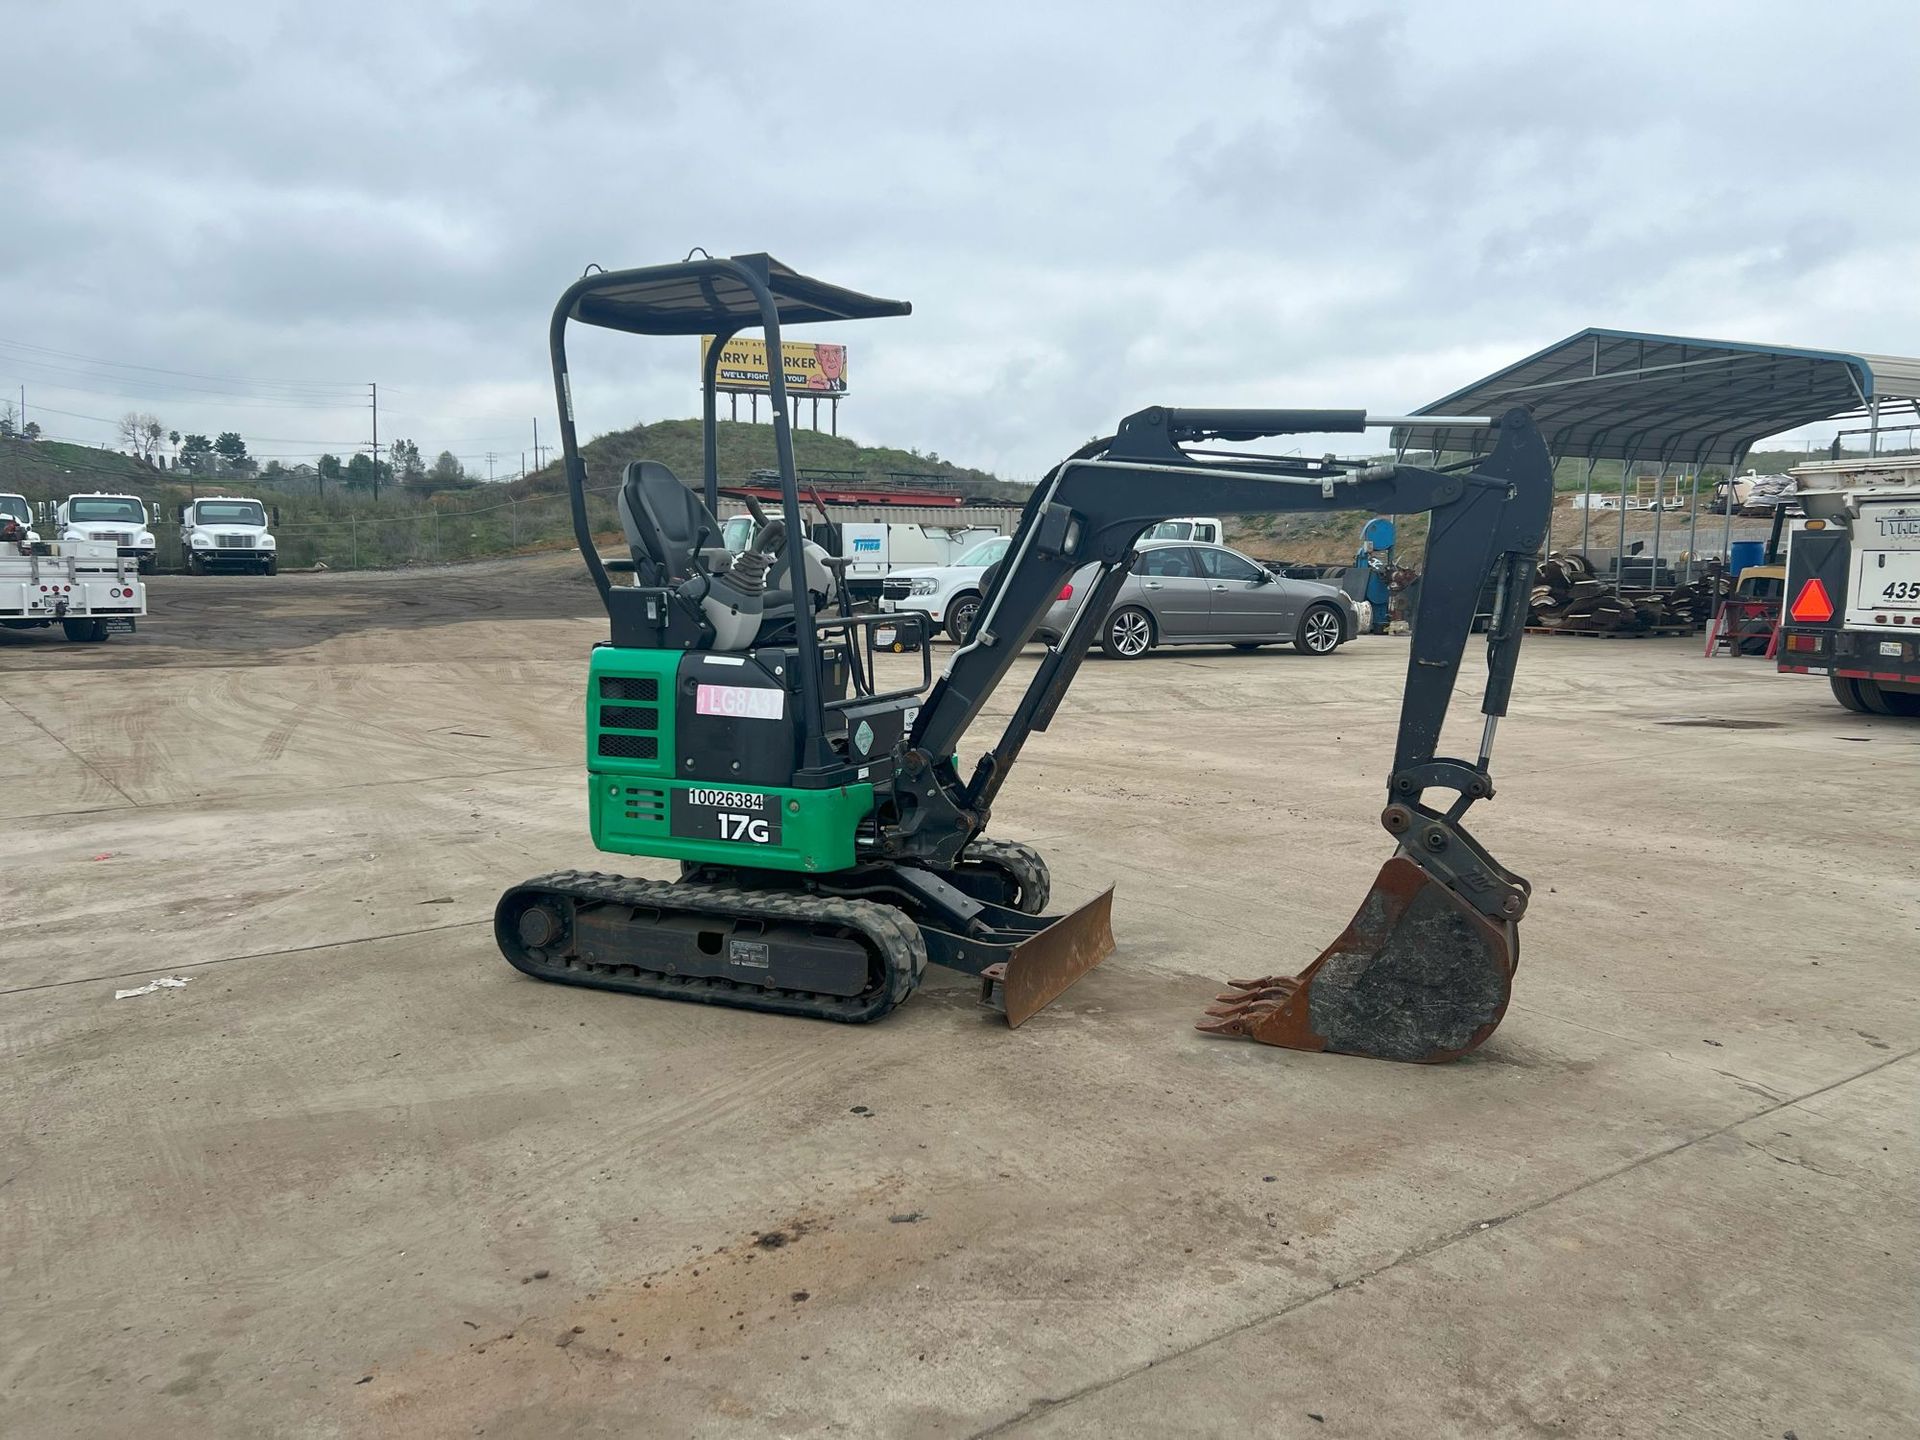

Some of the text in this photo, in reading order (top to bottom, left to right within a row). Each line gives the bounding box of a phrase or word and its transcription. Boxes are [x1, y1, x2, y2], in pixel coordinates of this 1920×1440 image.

[747, 372, 769, 381] FIGHT
[689, 788, 763, 809] 10026384
[718, 813, 769, 843] 17G
